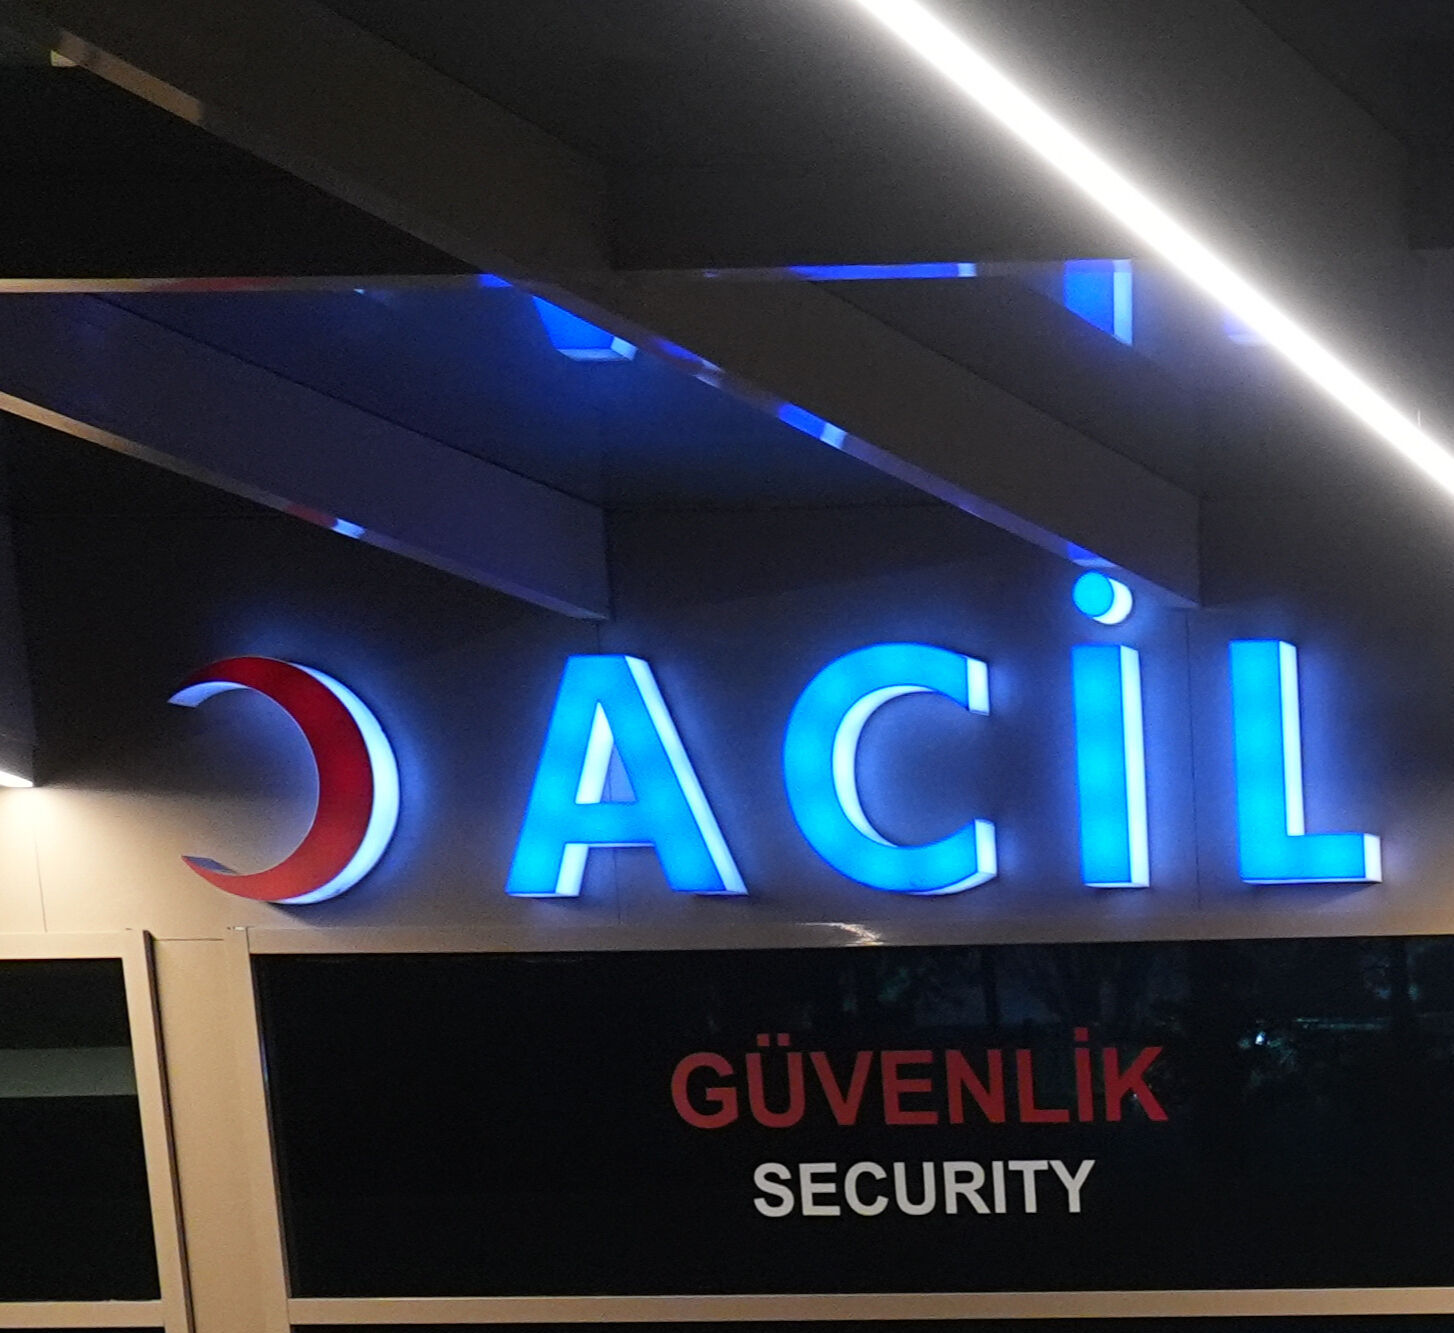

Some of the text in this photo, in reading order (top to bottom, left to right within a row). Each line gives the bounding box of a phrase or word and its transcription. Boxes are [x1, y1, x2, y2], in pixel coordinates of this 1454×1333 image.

[506, 571, 1384, 898] ACİL
[670, 1026, 1169, 1130] GÜVENLİK
[752, 1158, 1097, 1219] SECURITY
